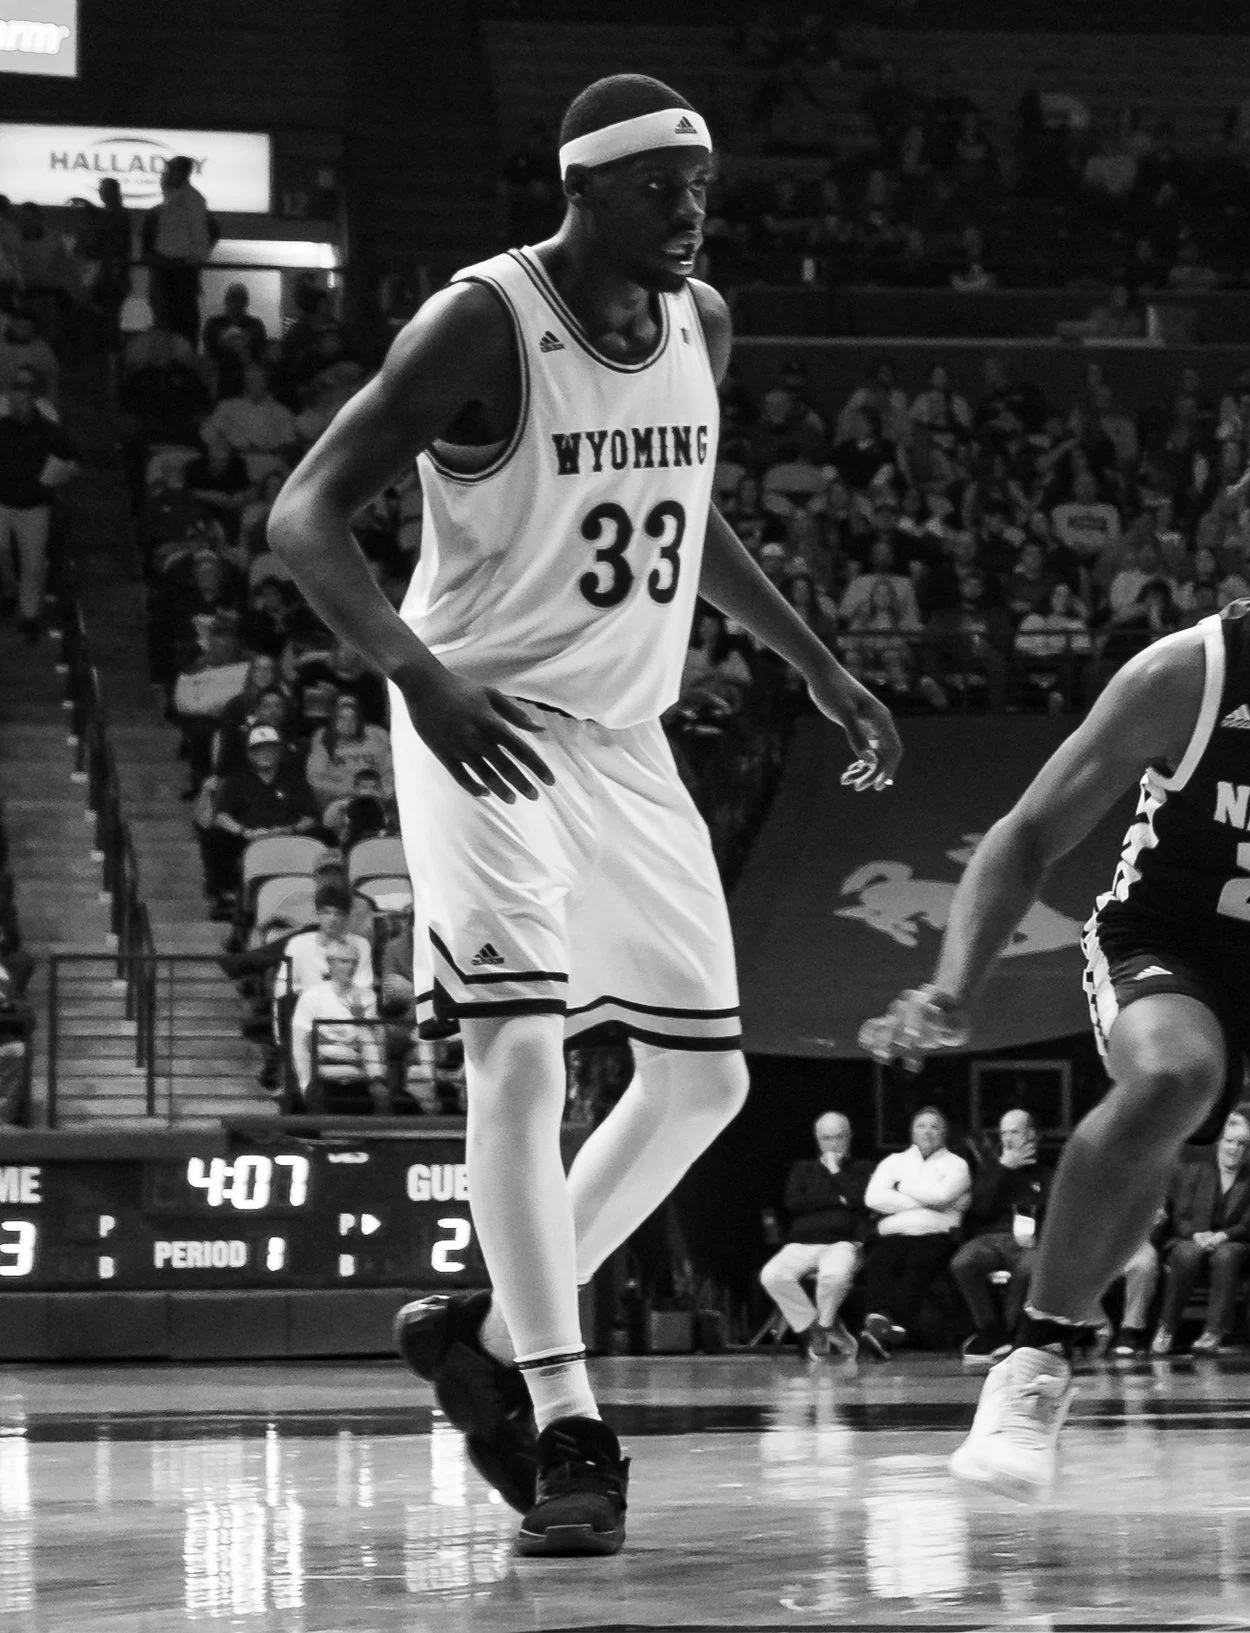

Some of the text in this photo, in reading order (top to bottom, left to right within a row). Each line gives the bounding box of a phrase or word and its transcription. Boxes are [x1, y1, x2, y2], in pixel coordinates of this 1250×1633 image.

[50, 150, 208, 175] HALLADY
[552, 425, 708, 475] WYOMING
[579, 500, 685, 608] 33
[187, 1155, 309, 1210] 4:07
[0, 1221, 37, 1277] 3
[99, 1214, 116, 1238] P
[339, 1213, 356, 1236] P
[431, 1217, 472, 1273] 2
[154, 1240, 248, 1269] PERIOD
